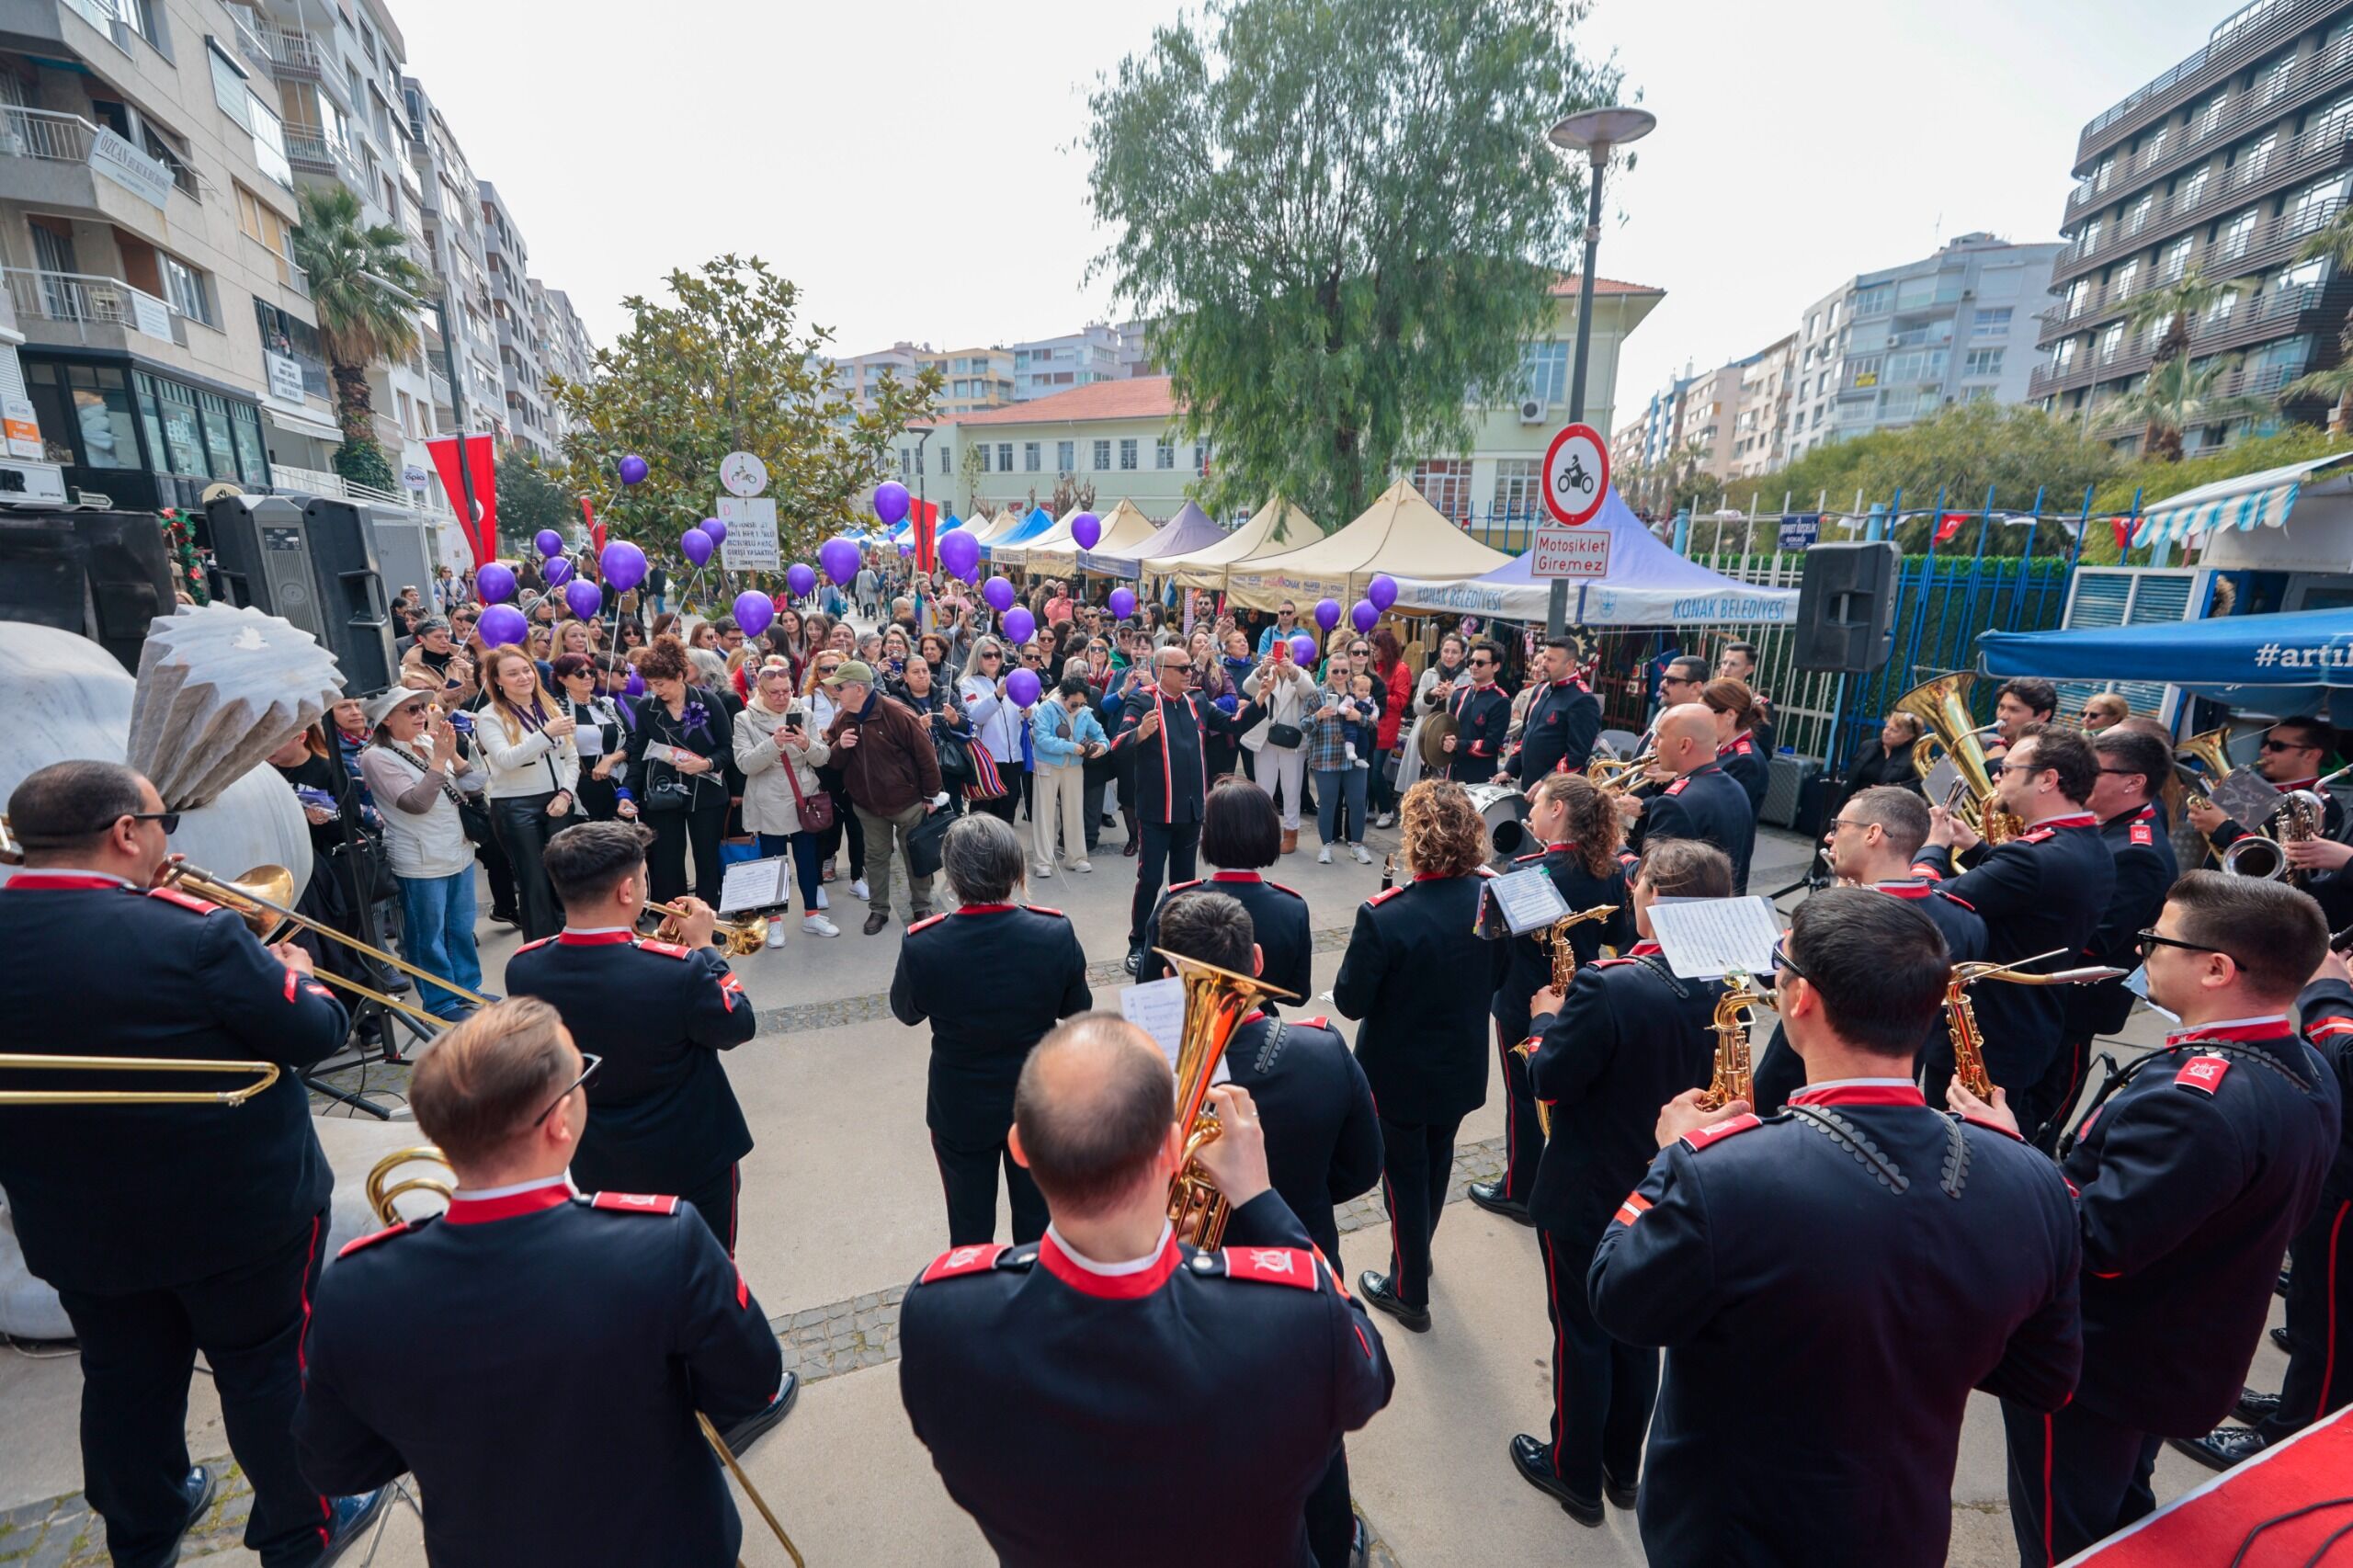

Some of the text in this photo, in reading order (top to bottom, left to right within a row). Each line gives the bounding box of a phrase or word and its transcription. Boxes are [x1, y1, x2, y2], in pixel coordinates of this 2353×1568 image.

[99, 131, 128, 164] ÖZCAN
[1539, 555, 1603, 571] Giremez
[1417, 587, 1503, 611] KONAK BELEDİYESİ
[1673, 595, 1787, 619] KONAK BELEDİYESİ
